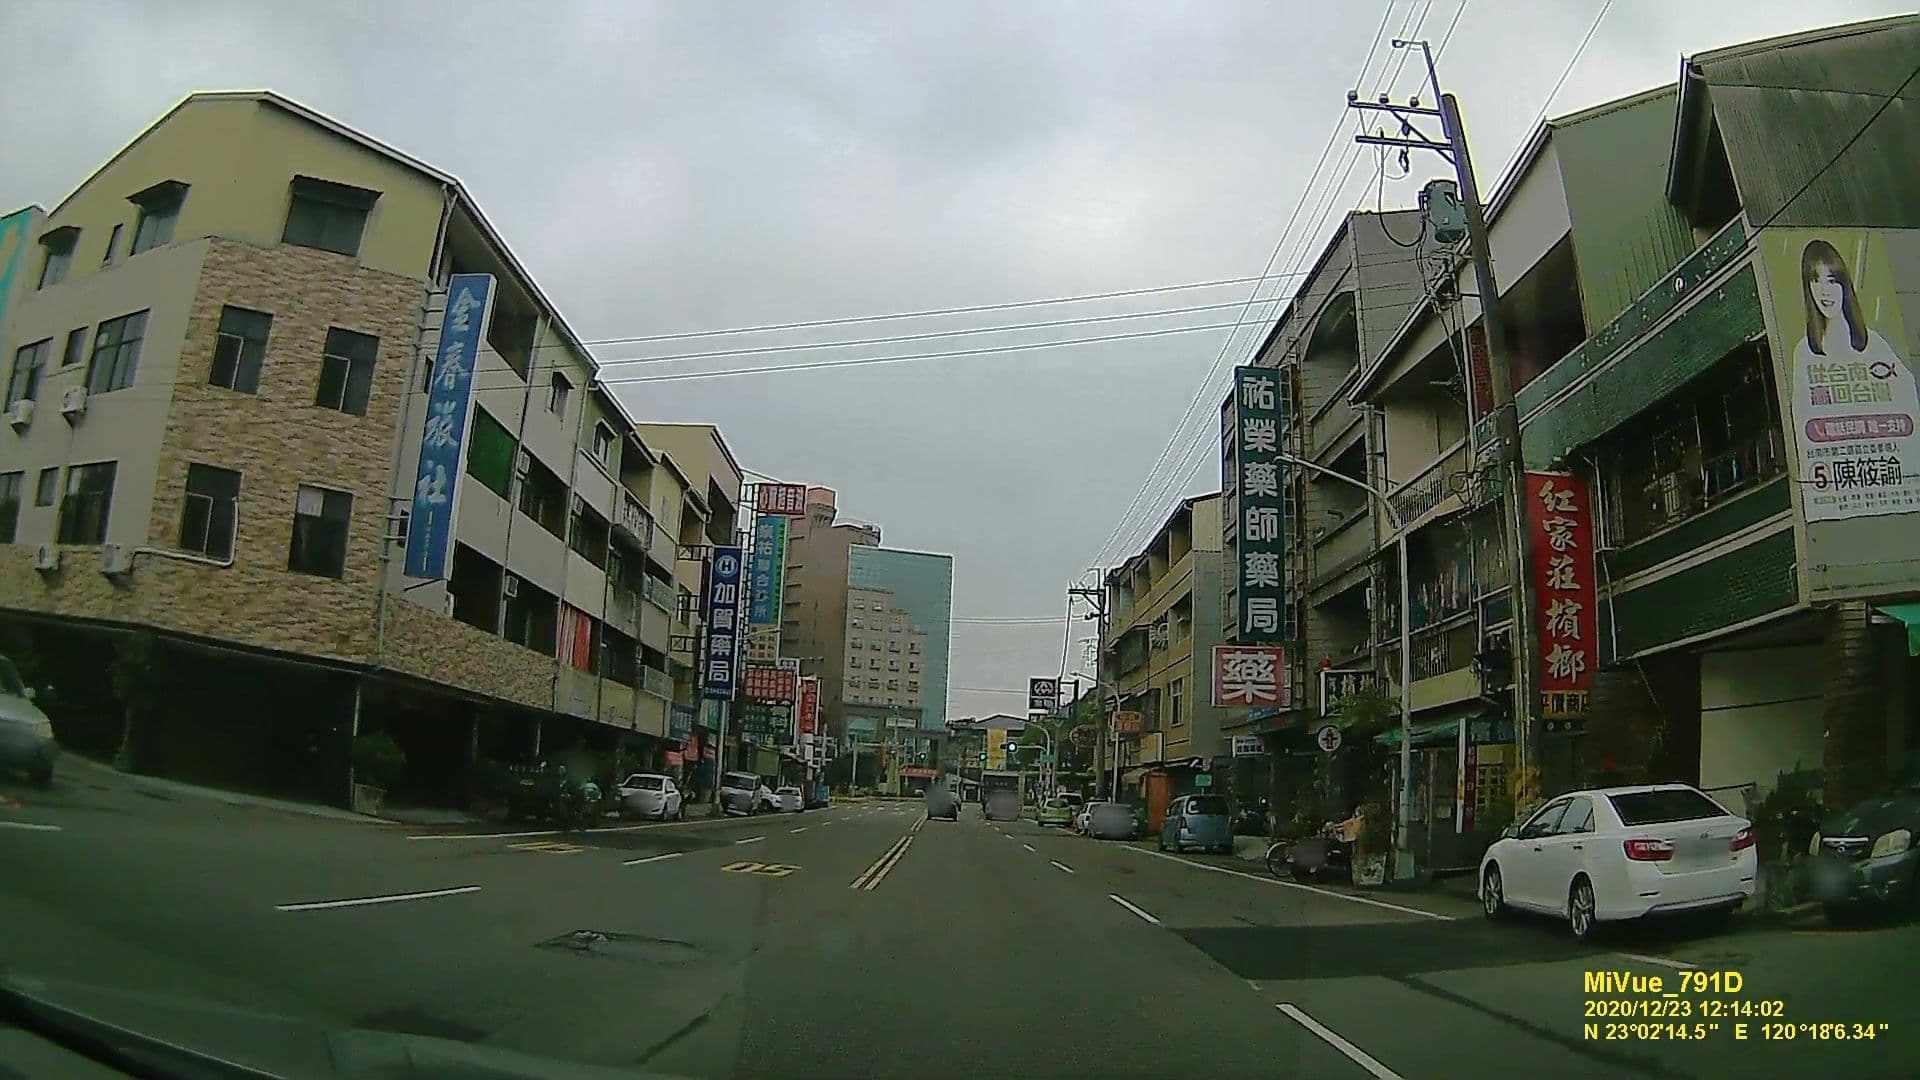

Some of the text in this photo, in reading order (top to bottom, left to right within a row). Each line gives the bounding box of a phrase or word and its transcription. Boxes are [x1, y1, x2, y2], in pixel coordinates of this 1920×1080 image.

[1242, 375, 1279, 636] 祐榮藥師藥局
[1814, 465, 1828, 489] 5
[1832, 455, 1902, 491] 陳筱諭
[1539, 480, 1586, 685] 紅家莊檳榔
[708, 582, 736, 683] 加賀藥局
[1221, 650, 1278, 703] 藥
